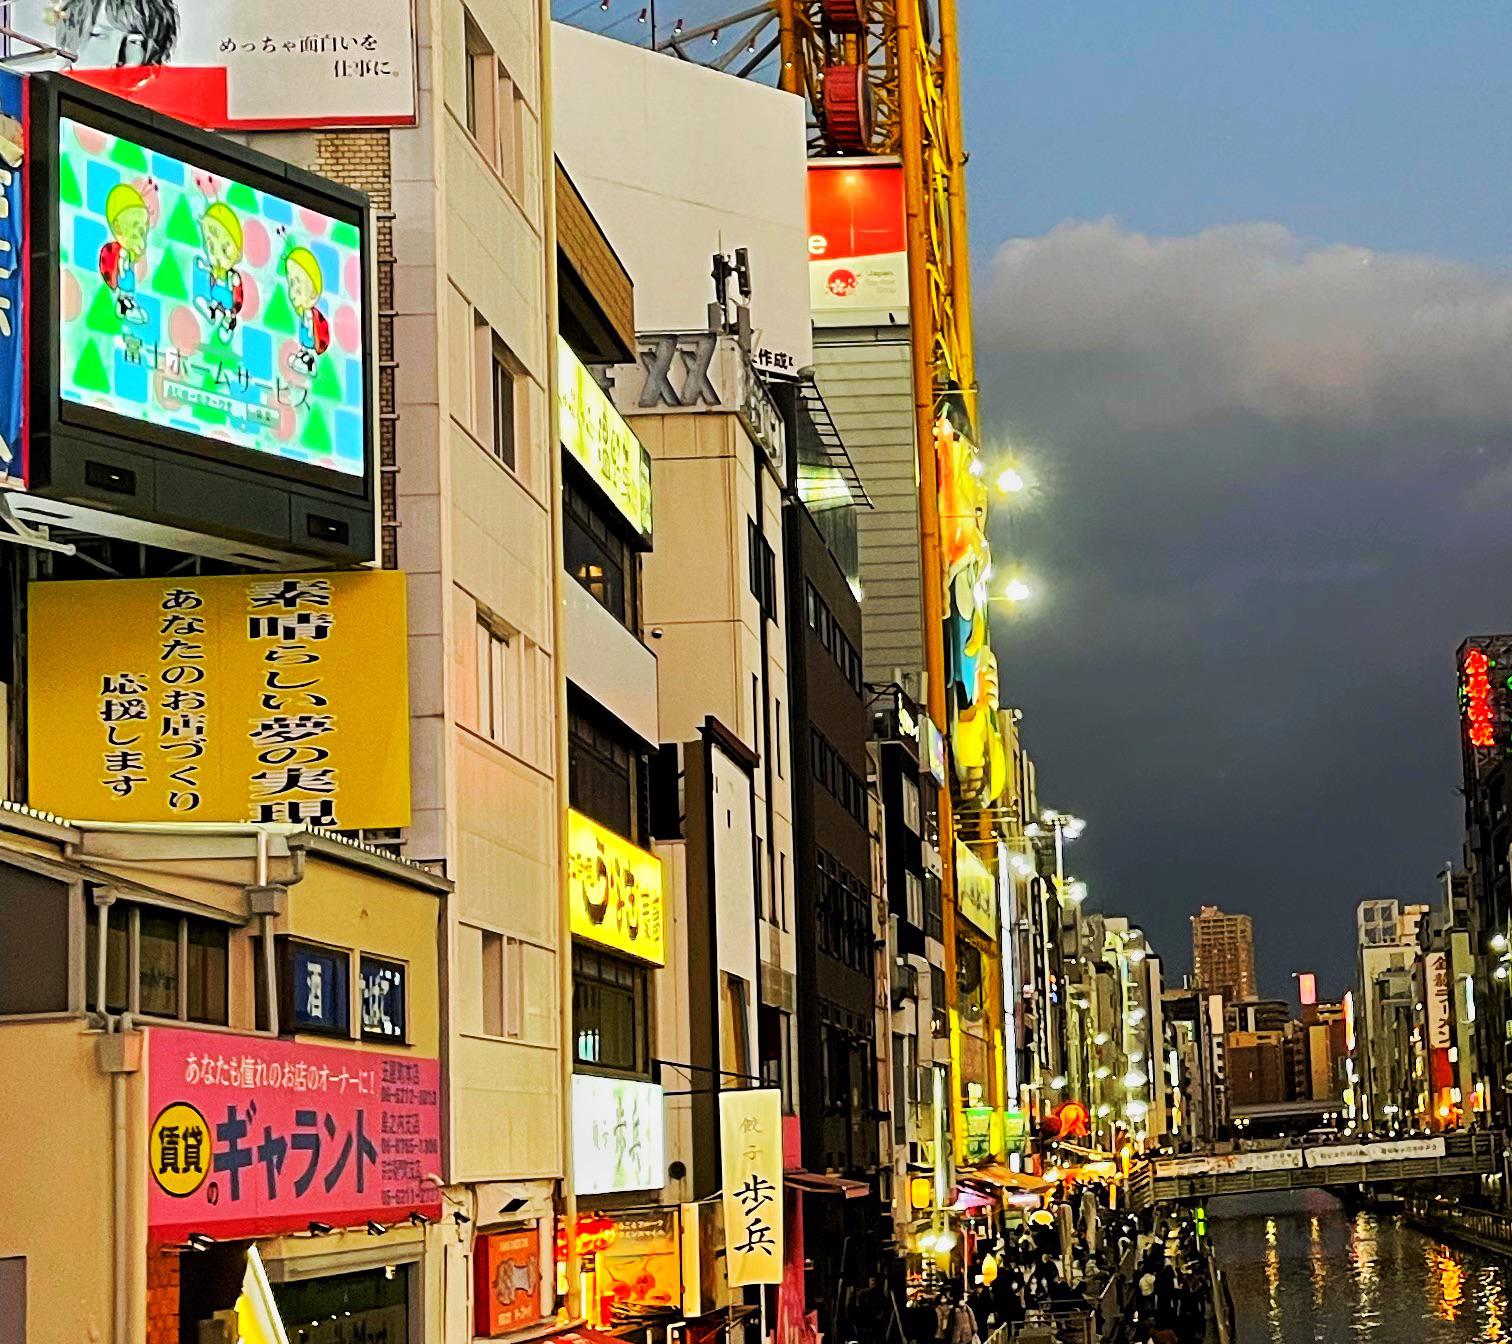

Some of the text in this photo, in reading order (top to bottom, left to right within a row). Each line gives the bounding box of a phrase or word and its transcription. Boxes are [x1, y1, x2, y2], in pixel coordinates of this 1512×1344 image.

[219, 34, 379, 53] めっちゃ面白いを
[121, 330, 312, 413] 富士ホームサービス
[99, 671, 149, 799] 応援します
[159, 588, 209, 813] あなたのお店づくり
[248, 578, 339, 827] 素晴らしい夢の実現
[159, 1125, 203, 1175] 賃貸
[206, 1180, 220, 1207] の
[213, 1099, 378, 1203] ギャラント
[733, 1174, 777, 1256] 歩兵
